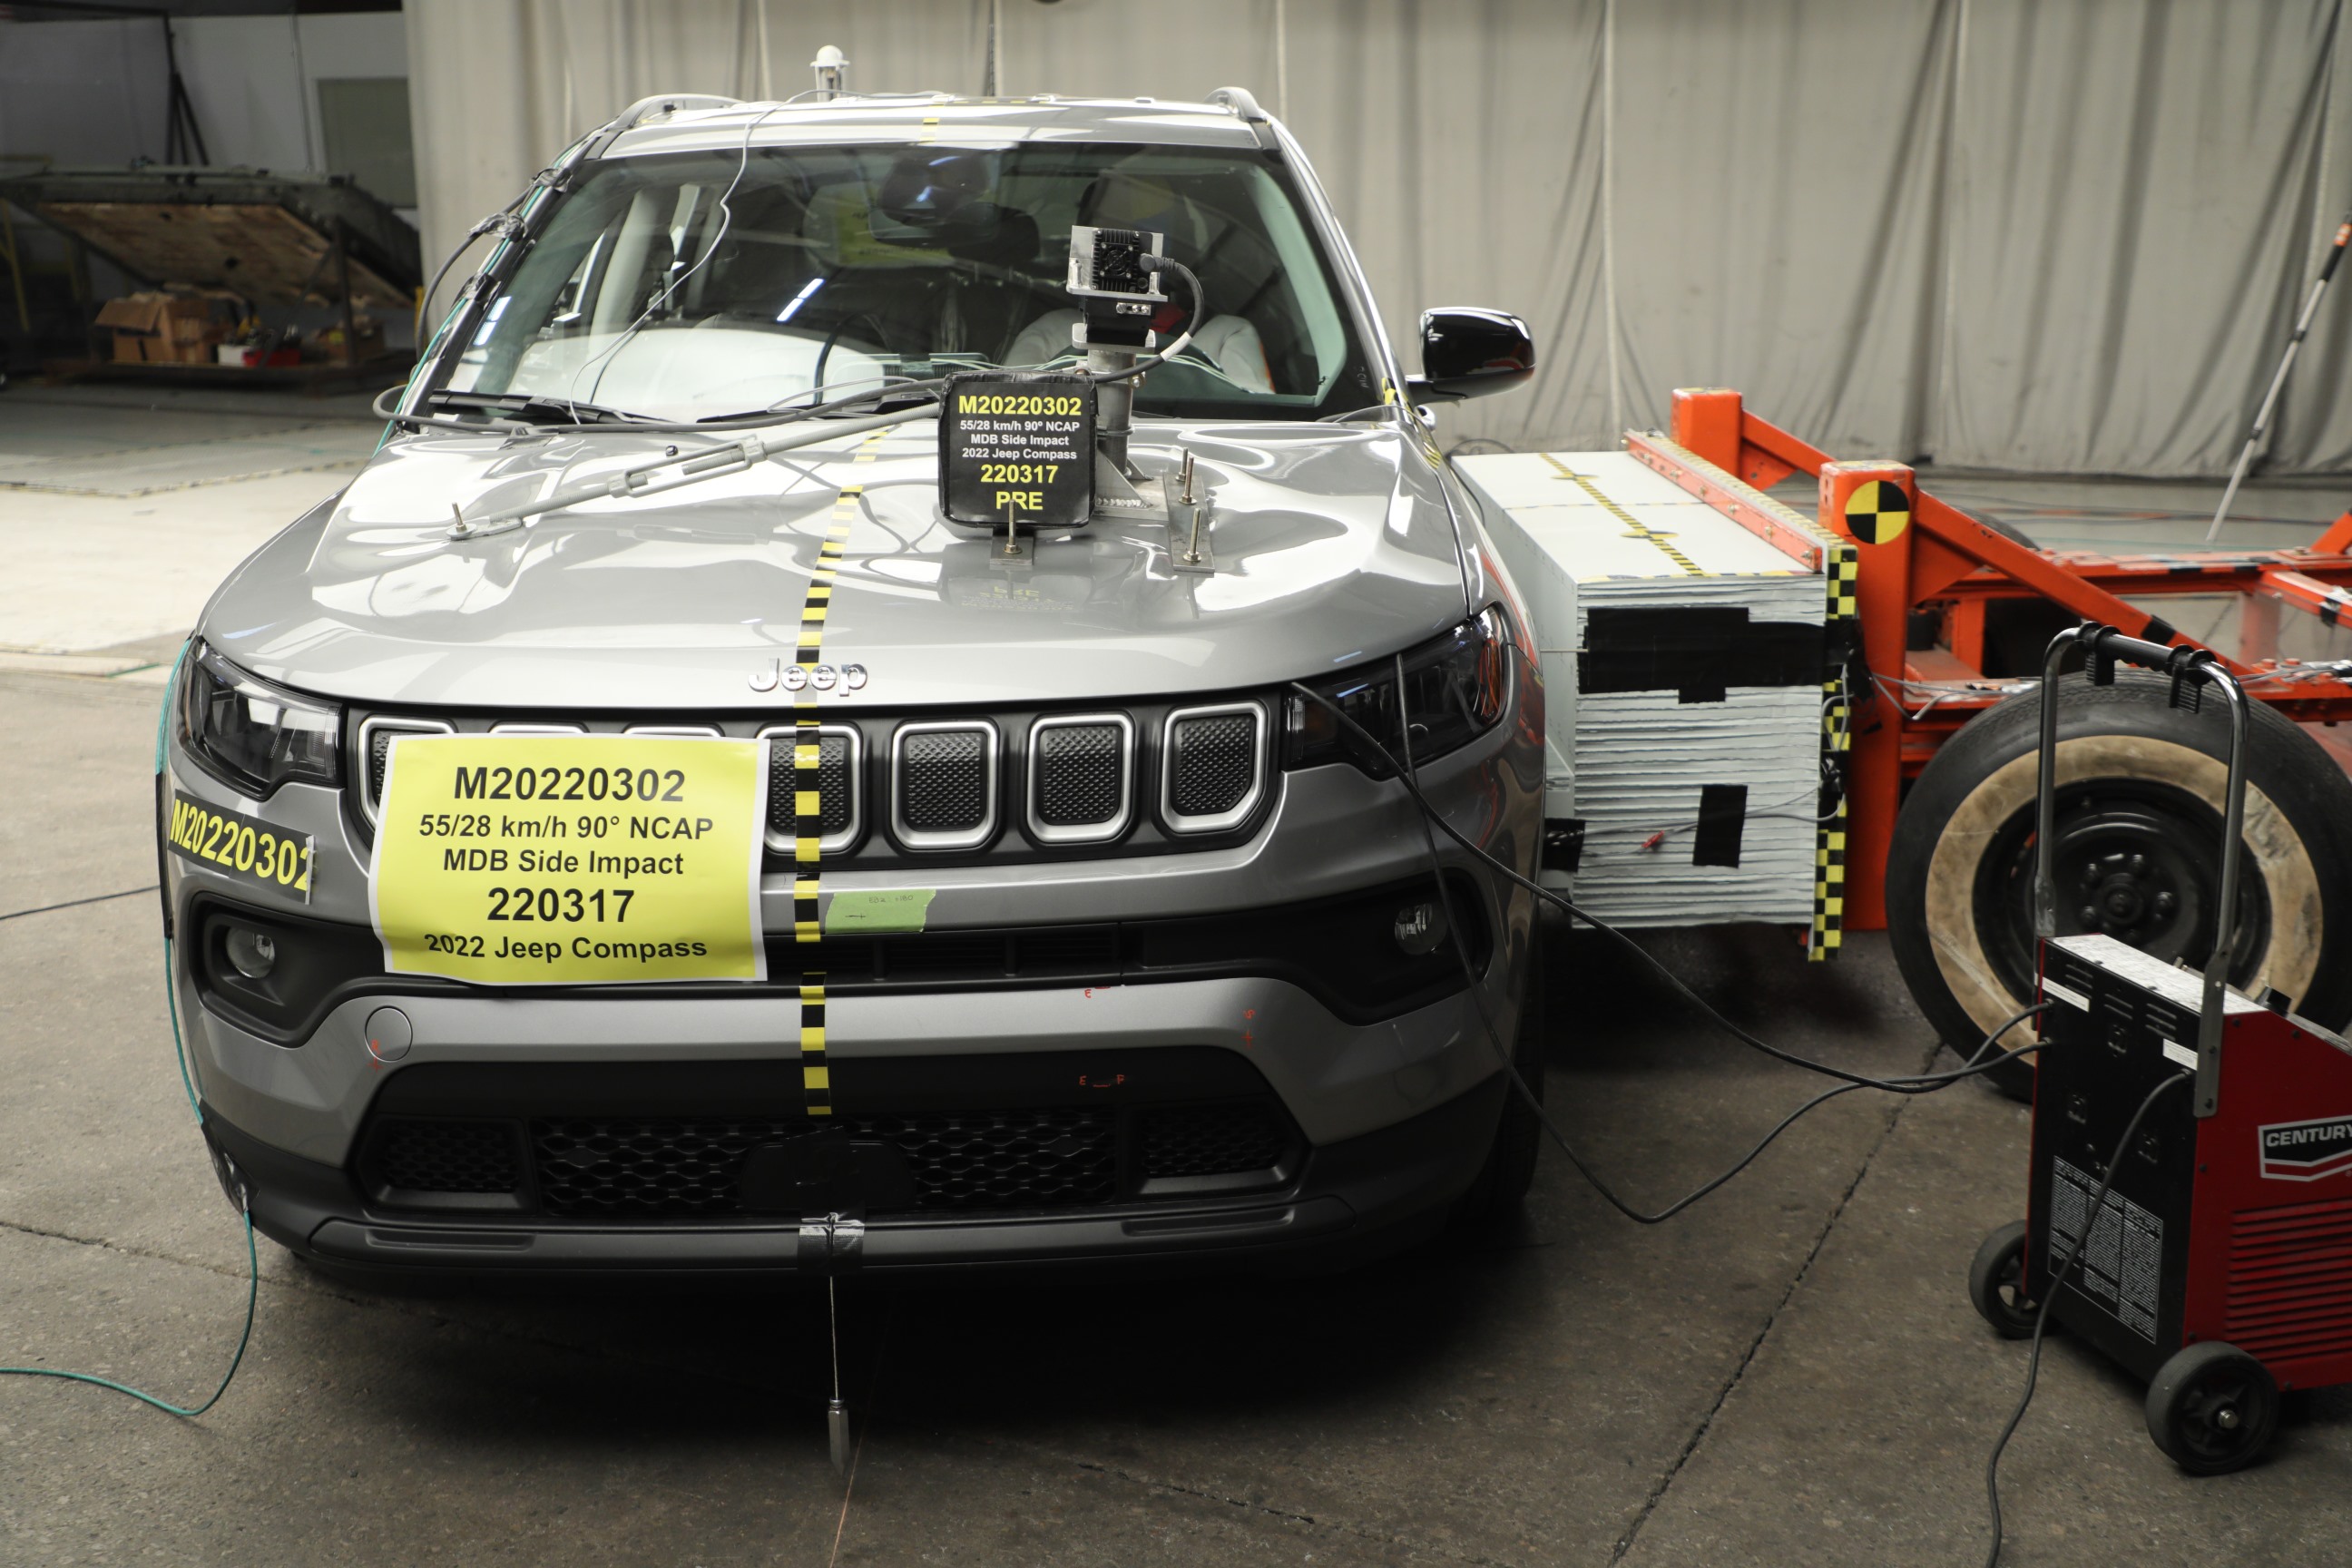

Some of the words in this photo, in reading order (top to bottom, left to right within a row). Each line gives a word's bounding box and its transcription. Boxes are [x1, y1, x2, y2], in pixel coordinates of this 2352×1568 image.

[958, 395, 1082, 416] M20220302
[959, 419, 991, 431] 55/28
[993, 420, 1022, 431] km/h
[1045, 420, 1081, 432] NCAP
[970, 433, 999, 445] MDB
[1001, 434, 1027, 446] Side
[1030, 434, 1070, 447] Impact
[962, 447, 990, 458] 2022
[992, 447, 1021, 461] Jeep
[1023, 447, 1077, 462] Compass
[980, 464, 1059, 484] 220317
[995, 491, 1044, 510] PRE
[748, 657, 868, 698] Jeep
[454, 766, 685, 802] M20220302
[419, 814, 491, 838] 55/28
[501, 815, 567, 838] km/h
[630, 816, 713, 840] NCAP
[444, 848, 508, 872] MDB
[518, 848, 579, 873] Side
[589, 850, 684, 880] Impact
[487, 887, 634, 923] 220317
[423, 933, 485, 958] 2022
[494, 936, 563, 964] Jeep
[572, 936, 708, 964] Compass
